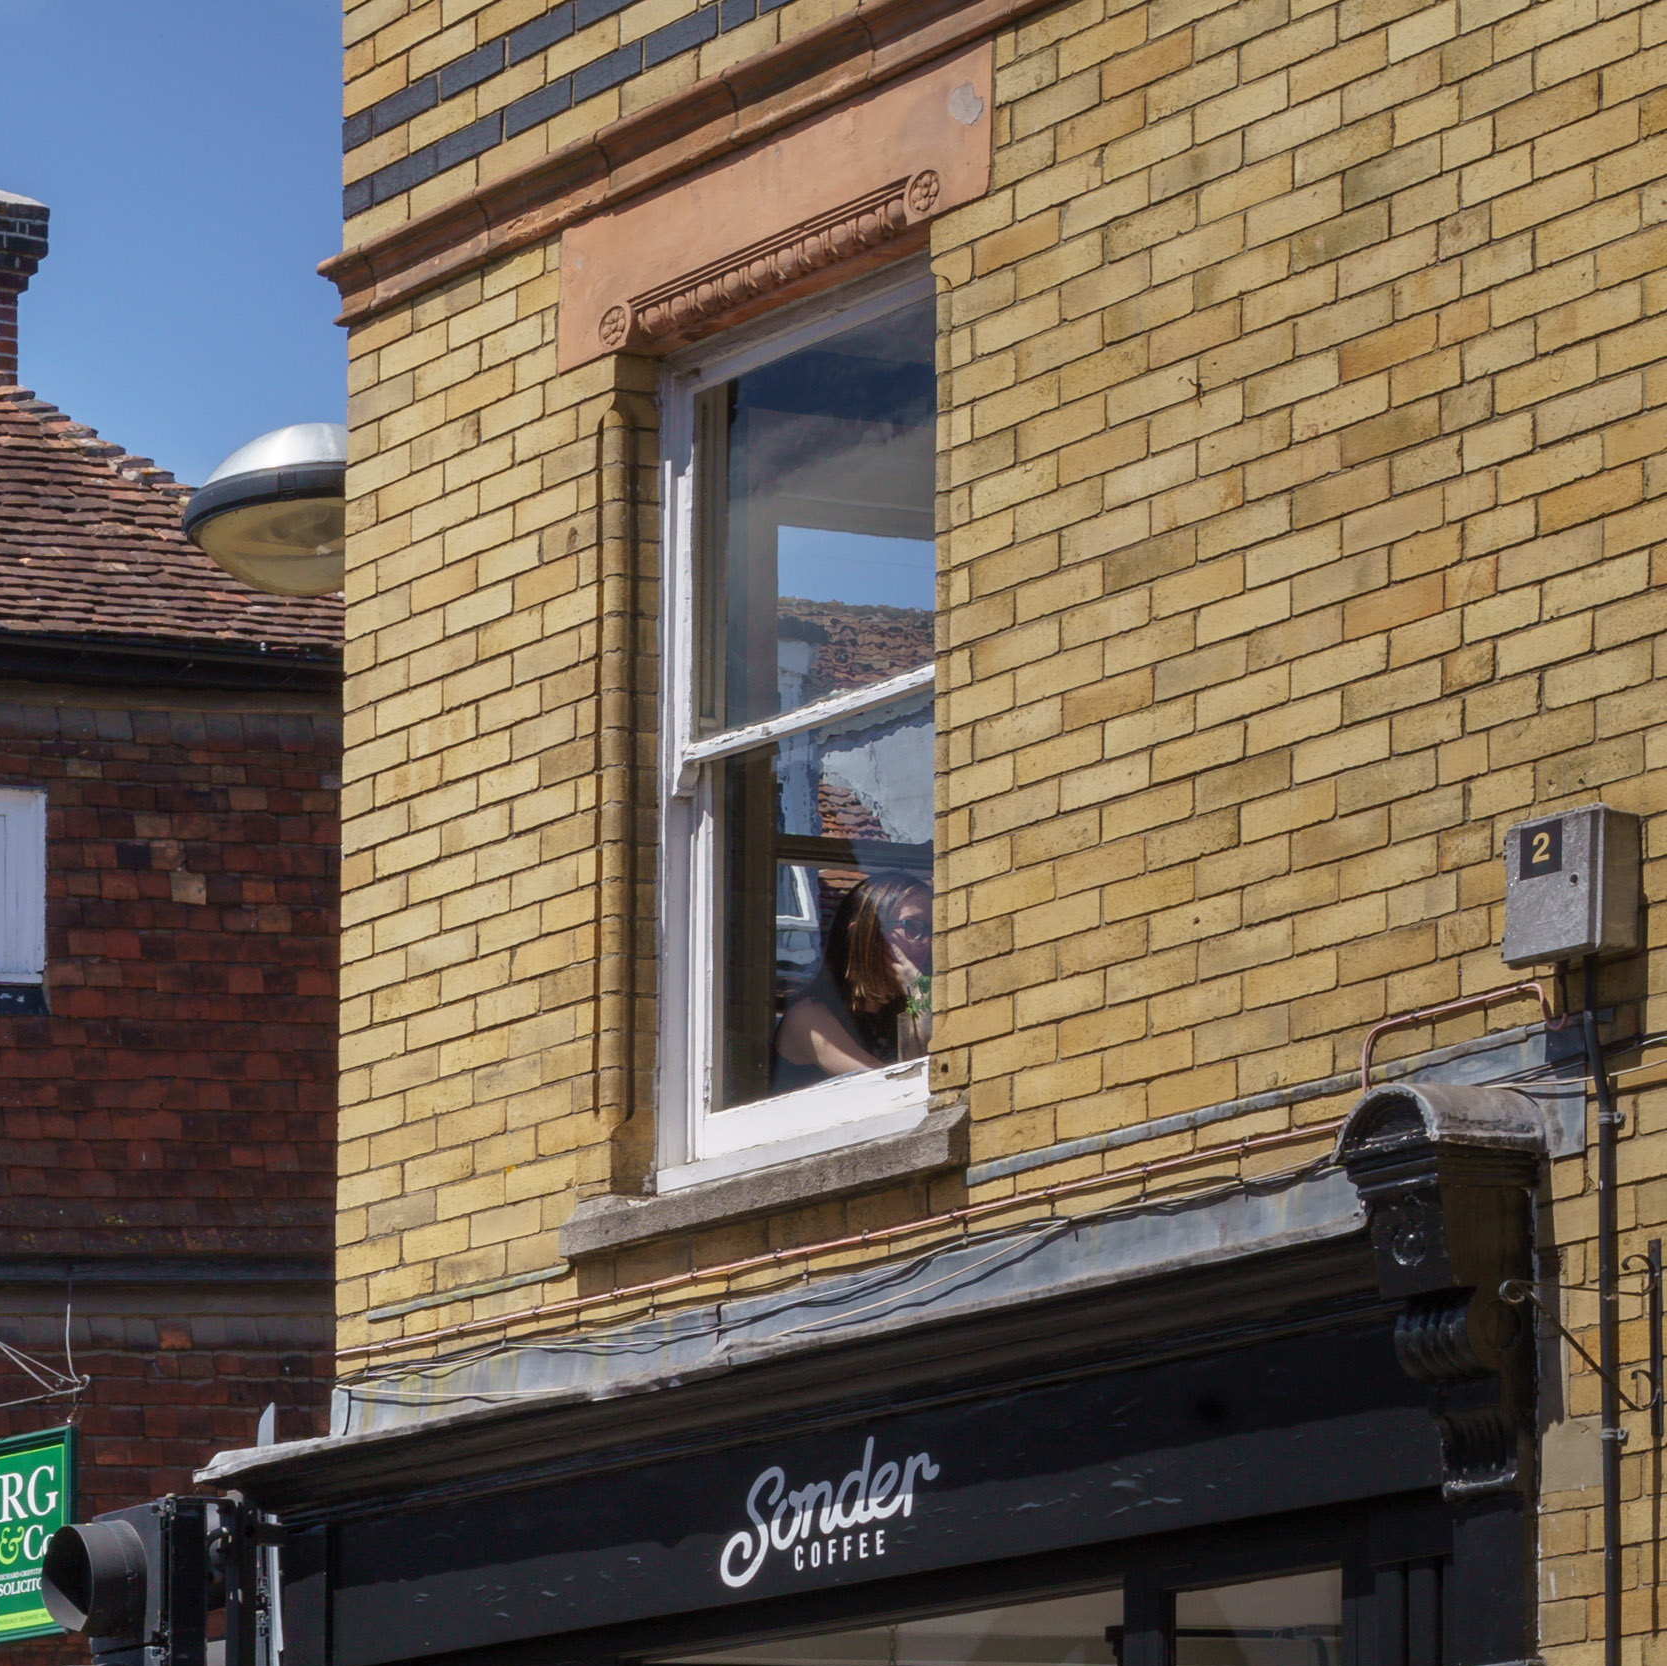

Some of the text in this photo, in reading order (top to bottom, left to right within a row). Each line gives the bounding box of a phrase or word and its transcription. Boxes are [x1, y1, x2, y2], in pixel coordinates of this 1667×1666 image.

[1532, 832, 1551, 864] 2
[720, 1436, 940, 1588] Sonder
[794, 1529, 885, 1571] COFFEE
